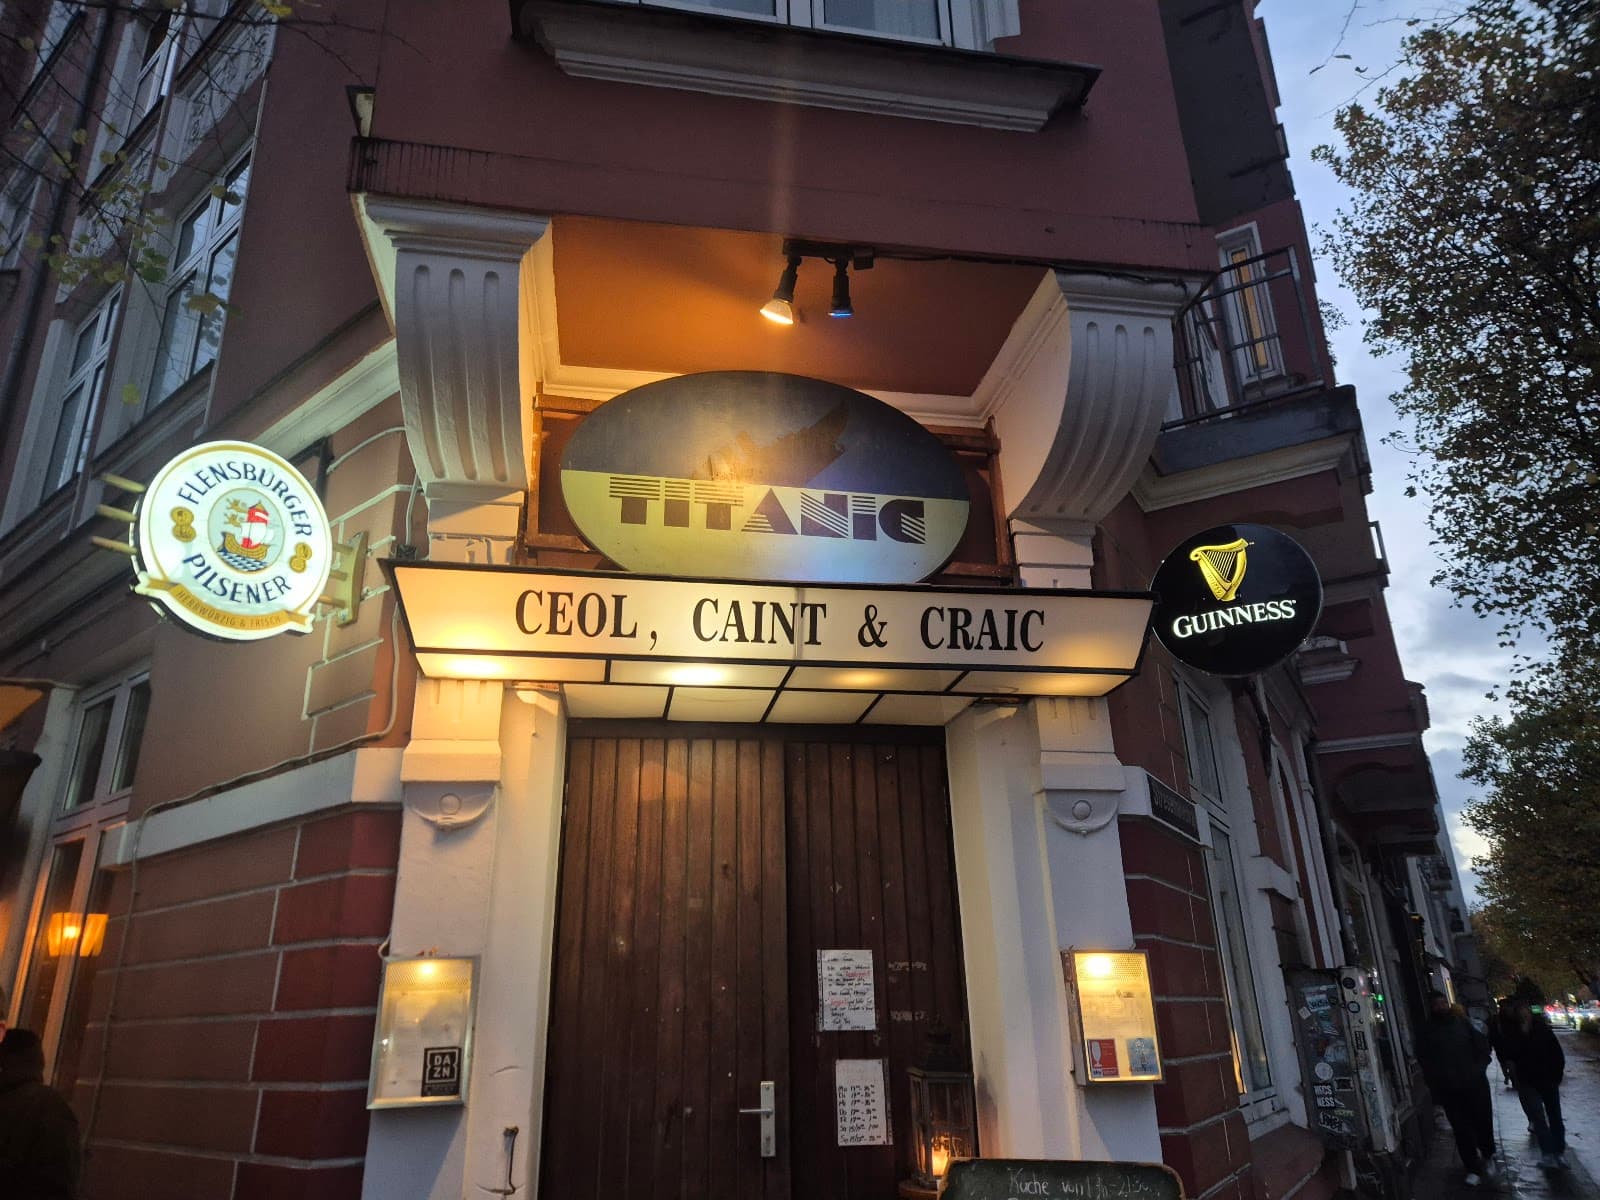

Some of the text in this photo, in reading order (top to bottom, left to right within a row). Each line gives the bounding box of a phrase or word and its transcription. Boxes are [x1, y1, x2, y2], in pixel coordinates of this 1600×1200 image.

[177, 461, 312, 537] FLENSBURGER
[609, 476, 926, 544] TITANIC
[183, 553, 292, 604] PILSENER
[515, 588, 1045, 652] CEOL, CAINT & CRAIC
[1172, 599, 1297, 639] GUINNESS
